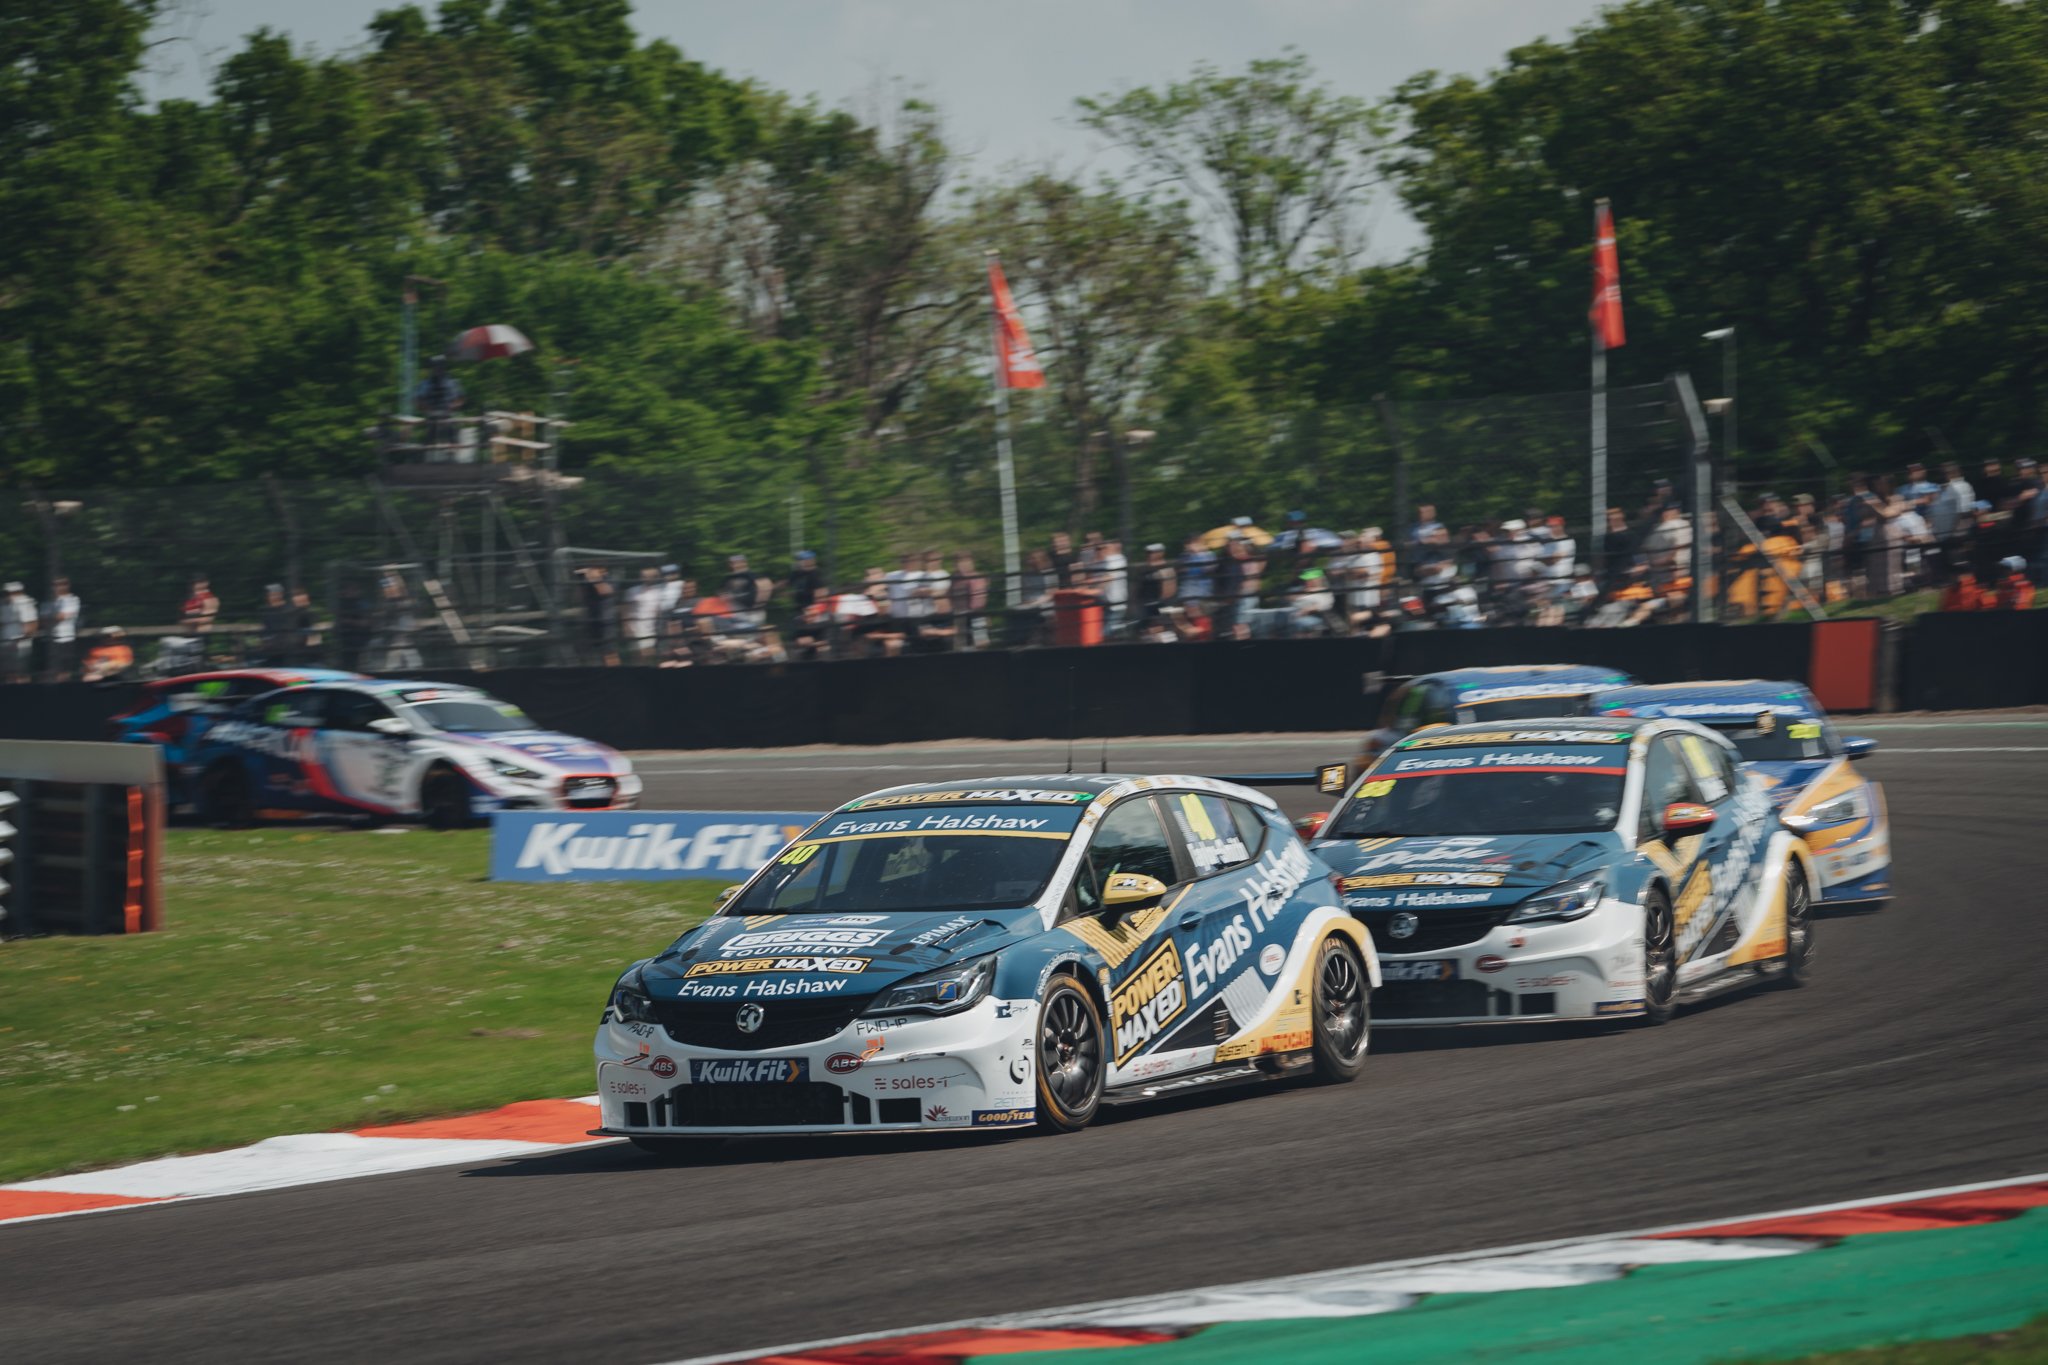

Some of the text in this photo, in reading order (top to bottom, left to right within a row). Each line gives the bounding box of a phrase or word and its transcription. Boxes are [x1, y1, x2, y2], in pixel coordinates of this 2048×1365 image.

[1395, 752, 1604, 772] Evans Halshaw
[864, 789, 1074, 806] POWER MAXED
[828, 814, 1049, 836] Evans Halshaw
[779, 845, 819, 866] 40
[1394, 892, 1493, 907] Halshaw
[1184, 914, 1253, 1000] Evans
[1239, 837, 1312, 932] Halshaw
[740, 929, 876, 944] BRIGGS
[911, 915, 974, 945] EPIMAX
[720, 946, 860, 958] EQUIPMENT
[690, 956, 864, 975] POWER MAXED
[678, 978, 848, 997] Evans Halshaw
[1113, 951, 1178, 1027] POWER
[1117, 980, 1183, 1057] MAXED
[653, 1062, 673, 1072] ABS
[831, 1058, 857, 1069] ABS
[617, 1081, 647, 1095] sales-i
[892, 1075, 949, 1090] sales-i
[978, 1109, 1035, 1123] GOODYEAR
